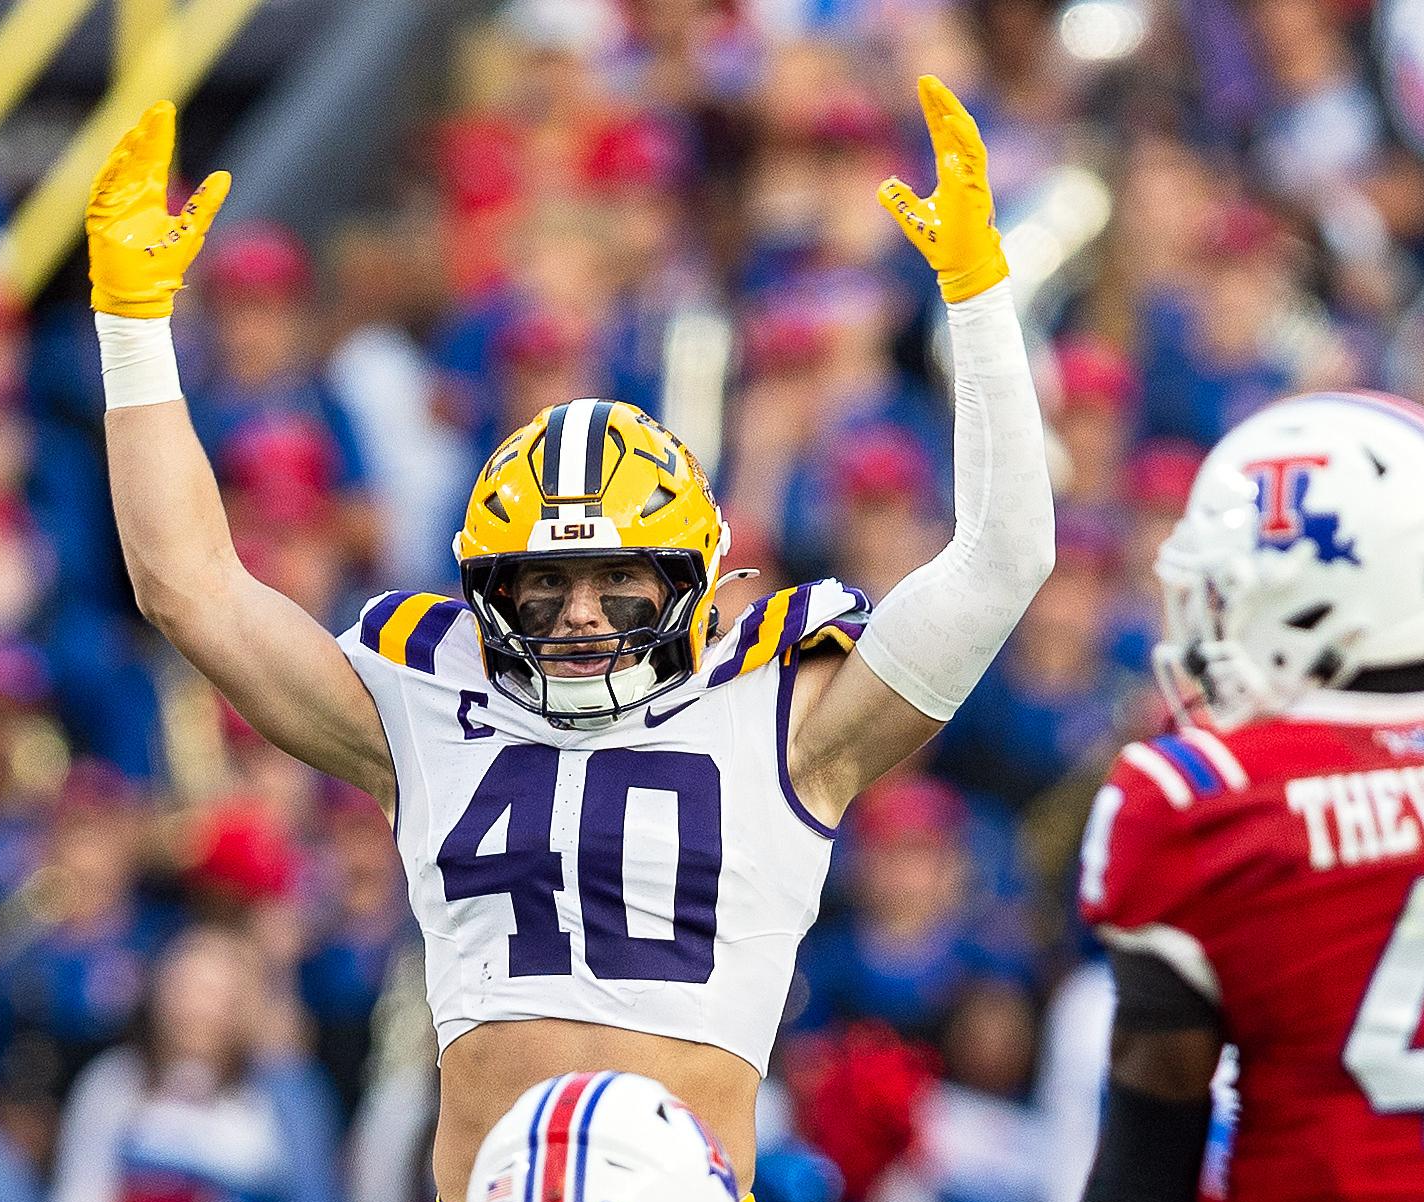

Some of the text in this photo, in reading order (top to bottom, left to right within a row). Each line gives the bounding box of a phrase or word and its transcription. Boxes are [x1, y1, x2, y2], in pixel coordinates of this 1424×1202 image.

[884, 182, 937, 243] TIGERS
[550, 523, 595, 541] LSU
[457, 689, 496, 740] C
[436, 743, 723, 985] 40
